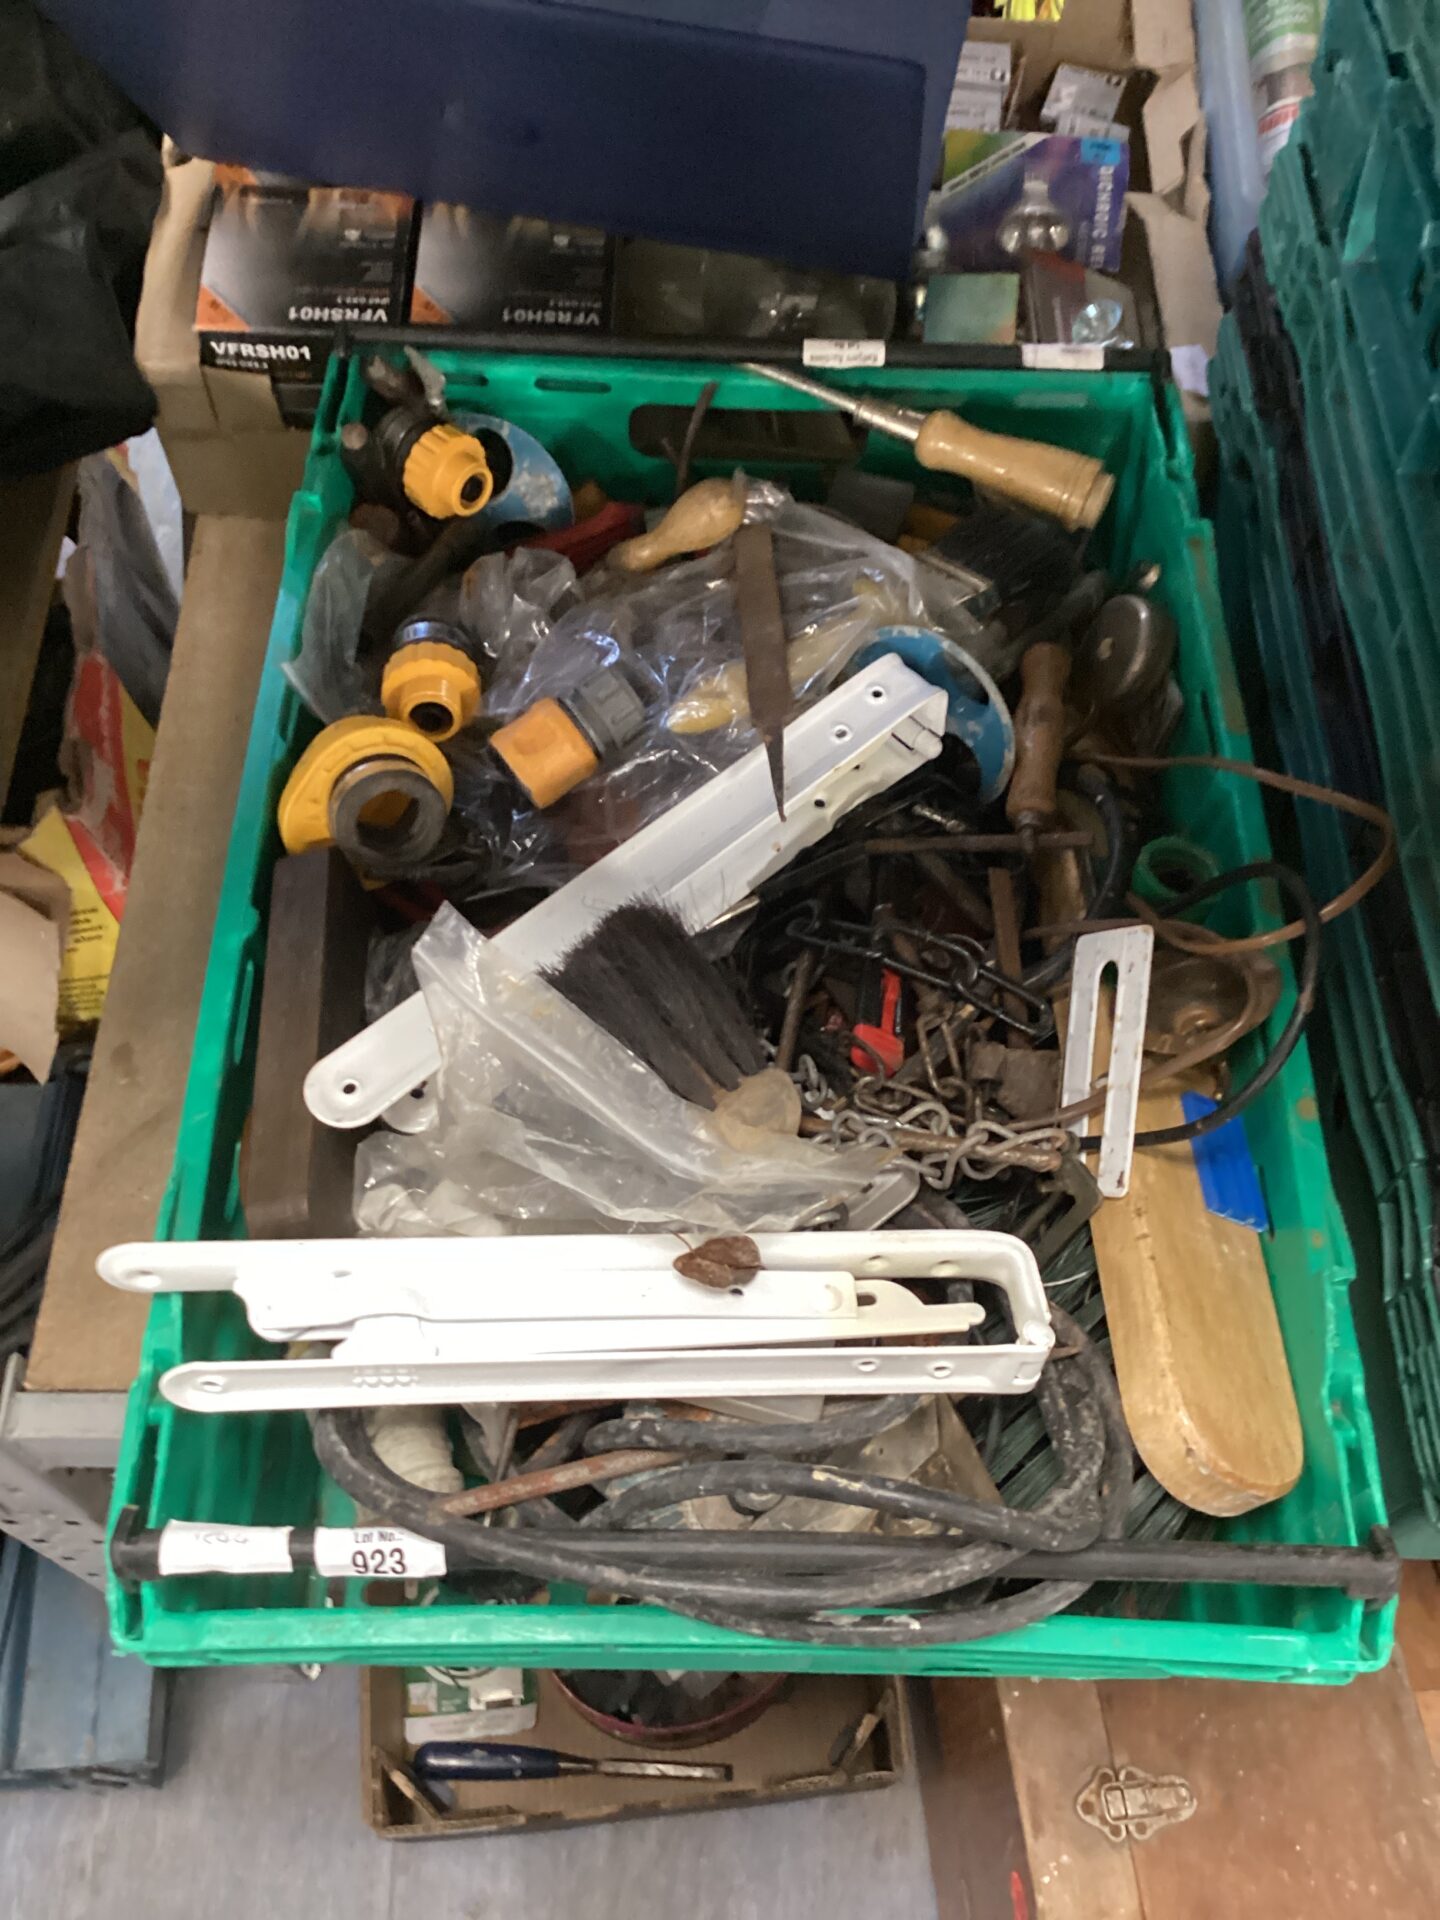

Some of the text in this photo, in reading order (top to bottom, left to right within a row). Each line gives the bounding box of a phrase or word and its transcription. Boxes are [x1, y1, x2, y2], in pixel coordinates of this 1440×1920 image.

[288, 306, 389, 323] VFRSH01
[502, 306, 601, 325] VFRSH01
[209, 341, 311, 361] VFRSH01
[353, 1531, 374, 1543] Lot
[351, 1547, 407, 1575] 923
